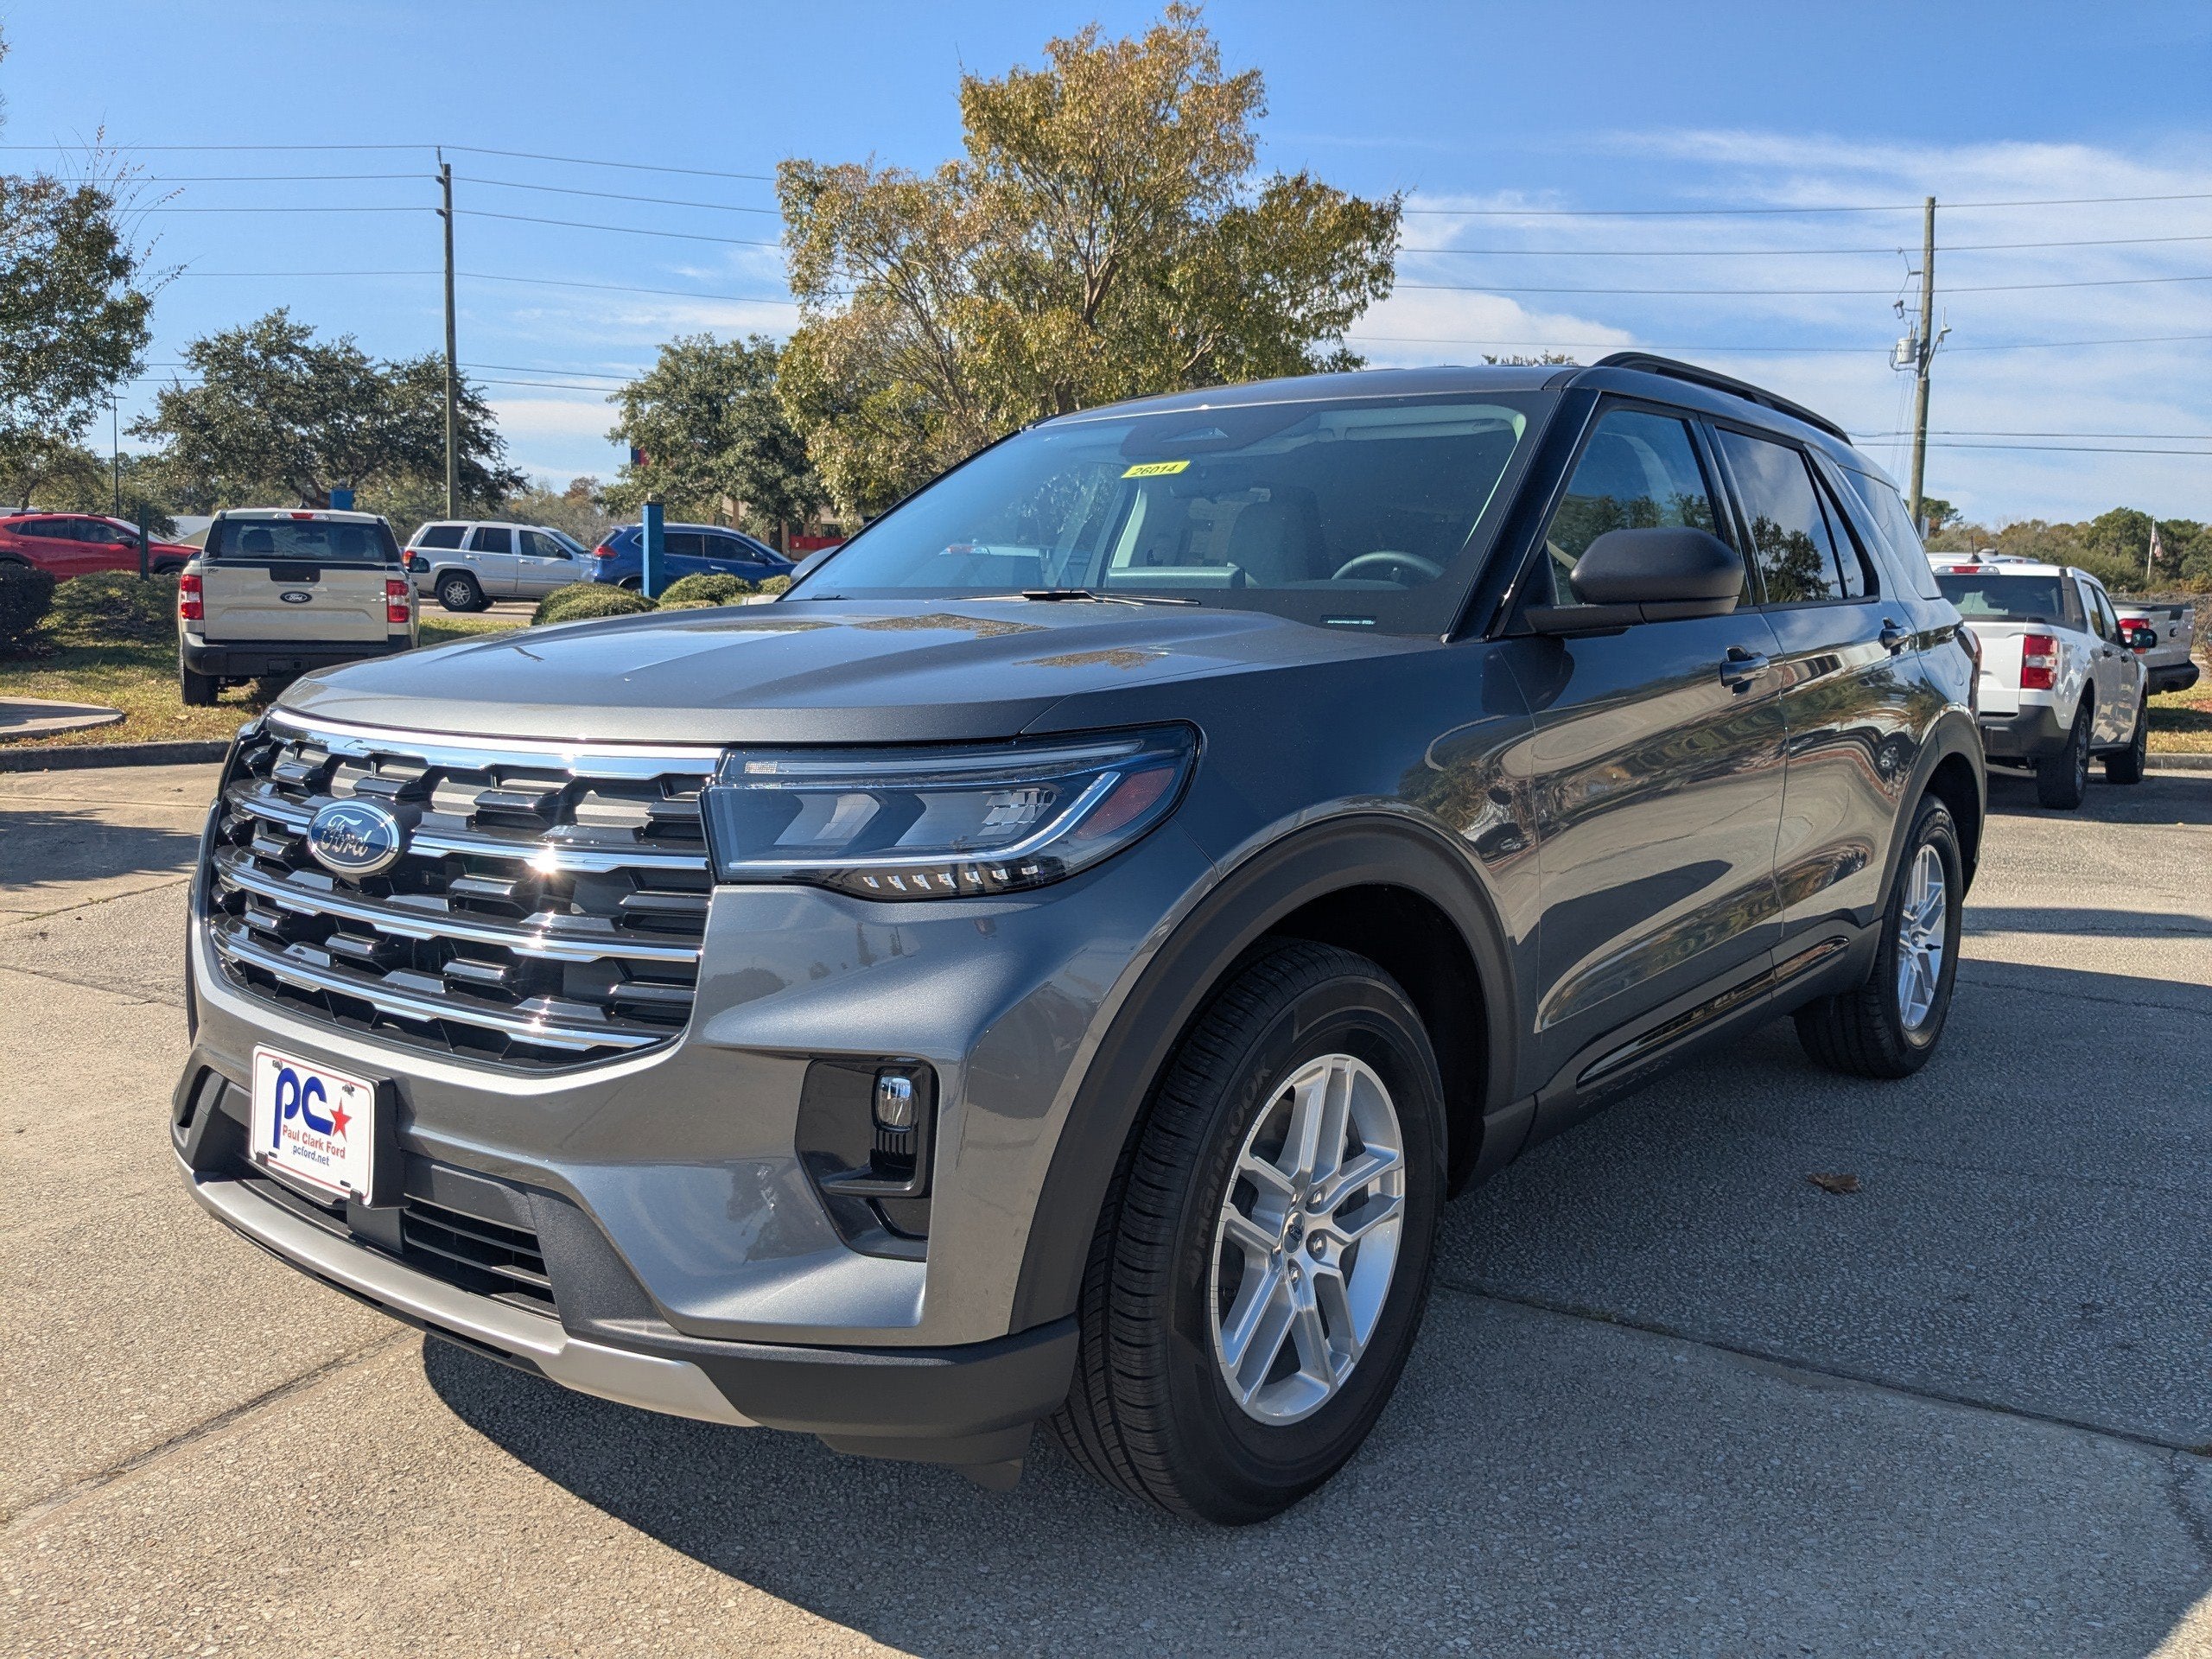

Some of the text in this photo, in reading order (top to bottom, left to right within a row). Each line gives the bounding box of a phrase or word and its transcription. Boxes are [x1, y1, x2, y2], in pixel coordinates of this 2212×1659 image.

[1130, 463, 1179, 476] 26014
[320, 814, 373, 857] Ford
[283, 1123, 346, 1160] Paul Clark Ford
[292, 1145, 330, 1166] pcford.net
